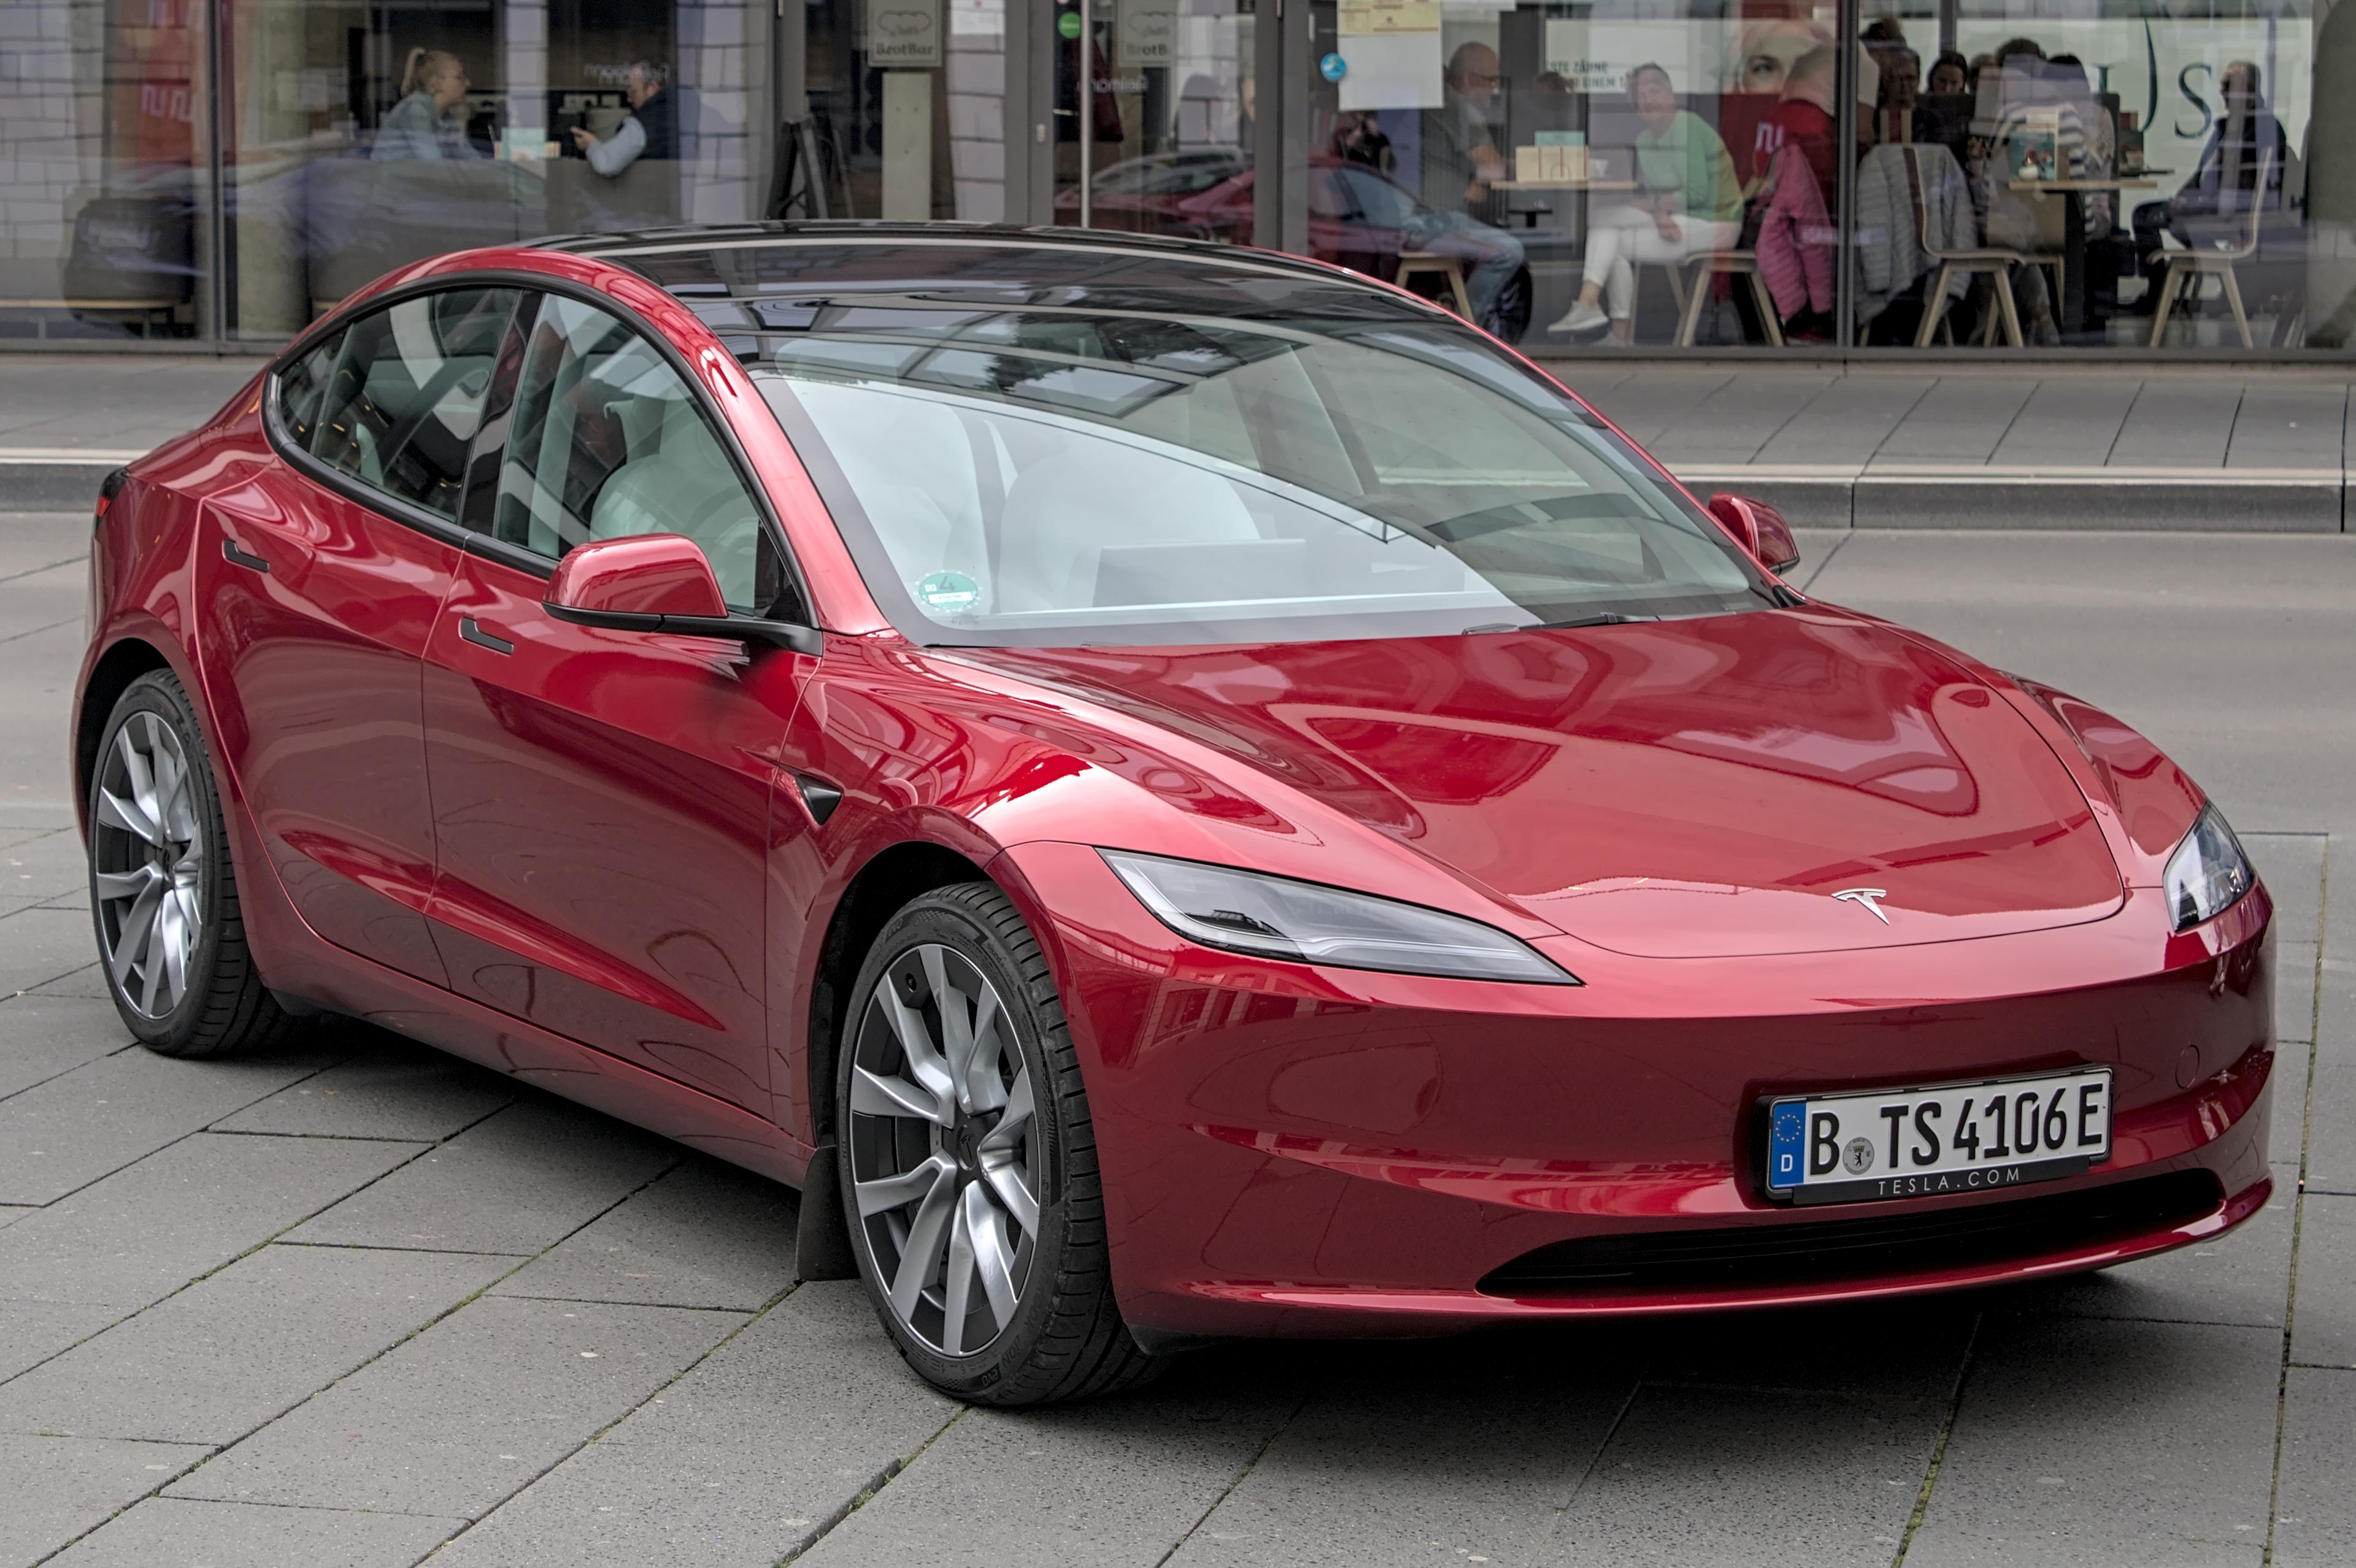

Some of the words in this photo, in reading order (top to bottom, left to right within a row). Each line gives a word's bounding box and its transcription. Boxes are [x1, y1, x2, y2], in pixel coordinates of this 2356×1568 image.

[1809, 1111, 1840, 1176] B
[1780, 1153, 1793, 1172] D
[1877, 1167, 2020, 1196] TESLA.COM
